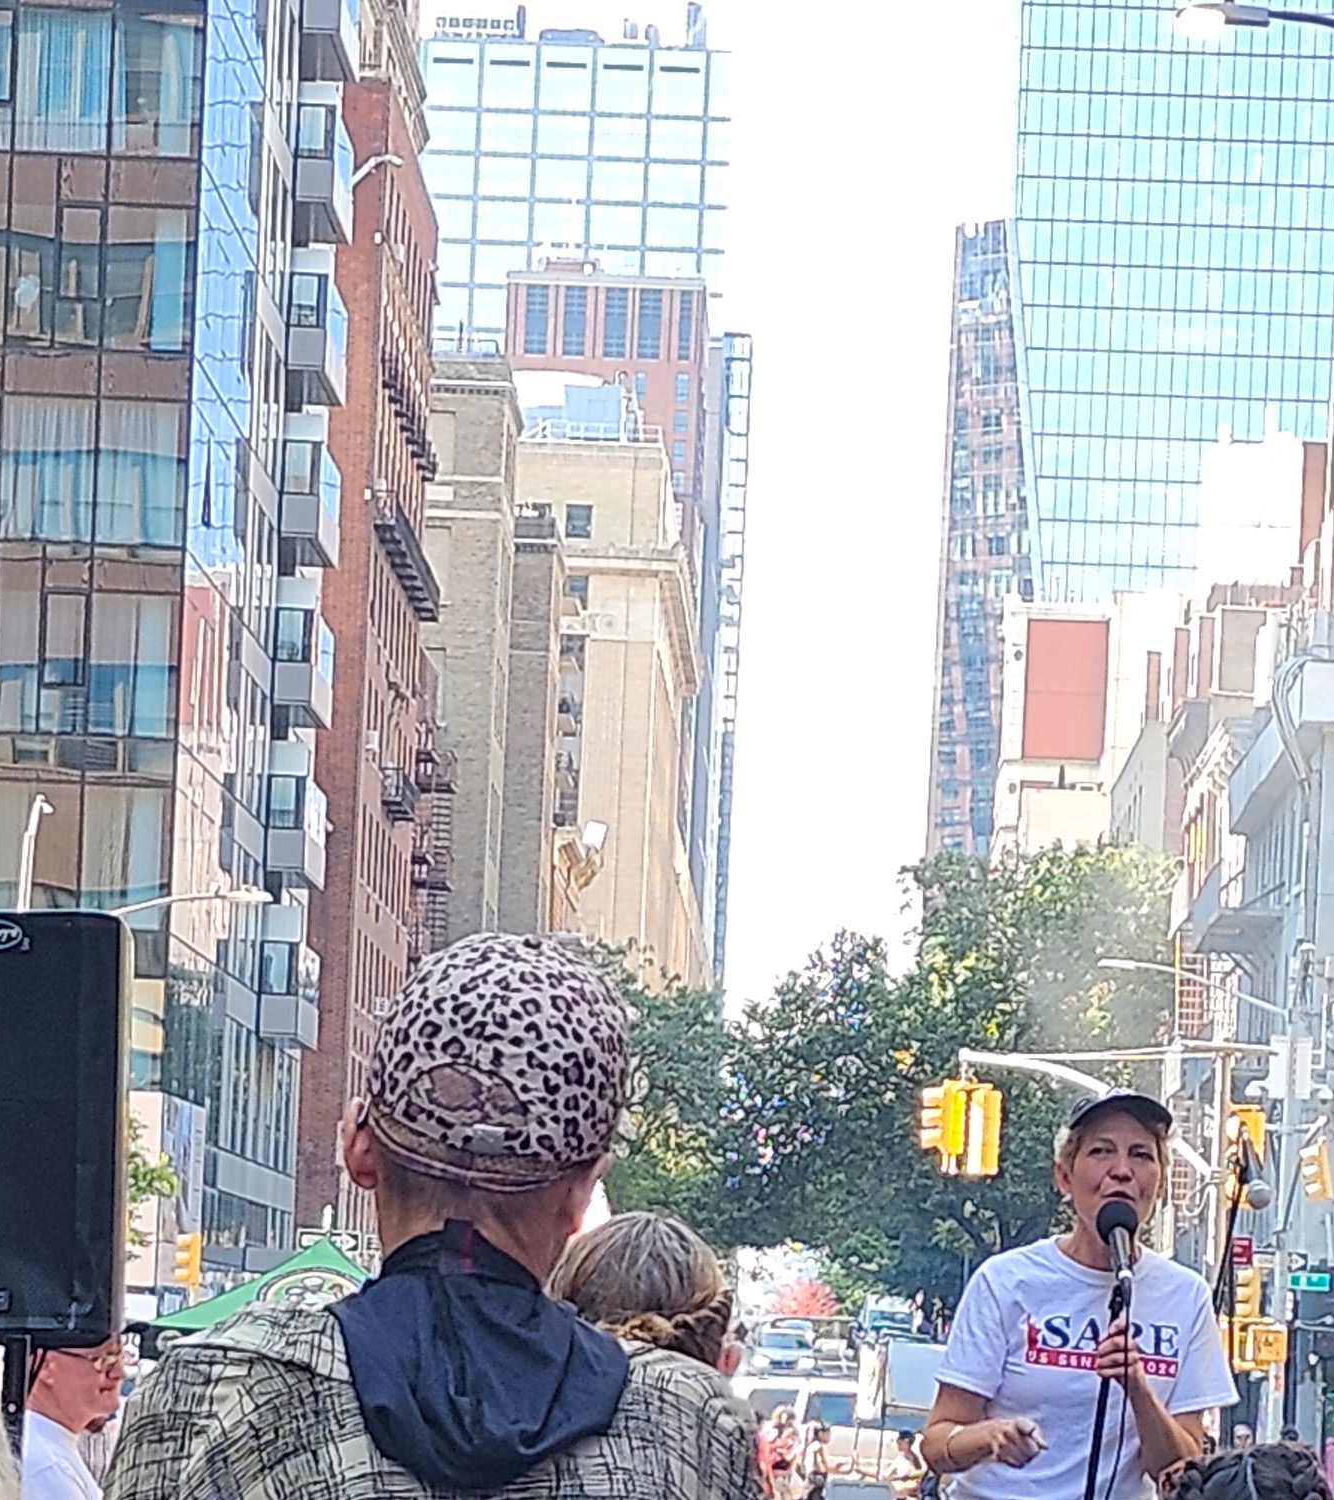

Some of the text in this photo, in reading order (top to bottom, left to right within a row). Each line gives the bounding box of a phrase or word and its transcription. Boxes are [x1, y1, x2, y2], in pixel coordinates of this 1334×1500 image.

[1027, 1349, 1178, 1375] US SEN 024
